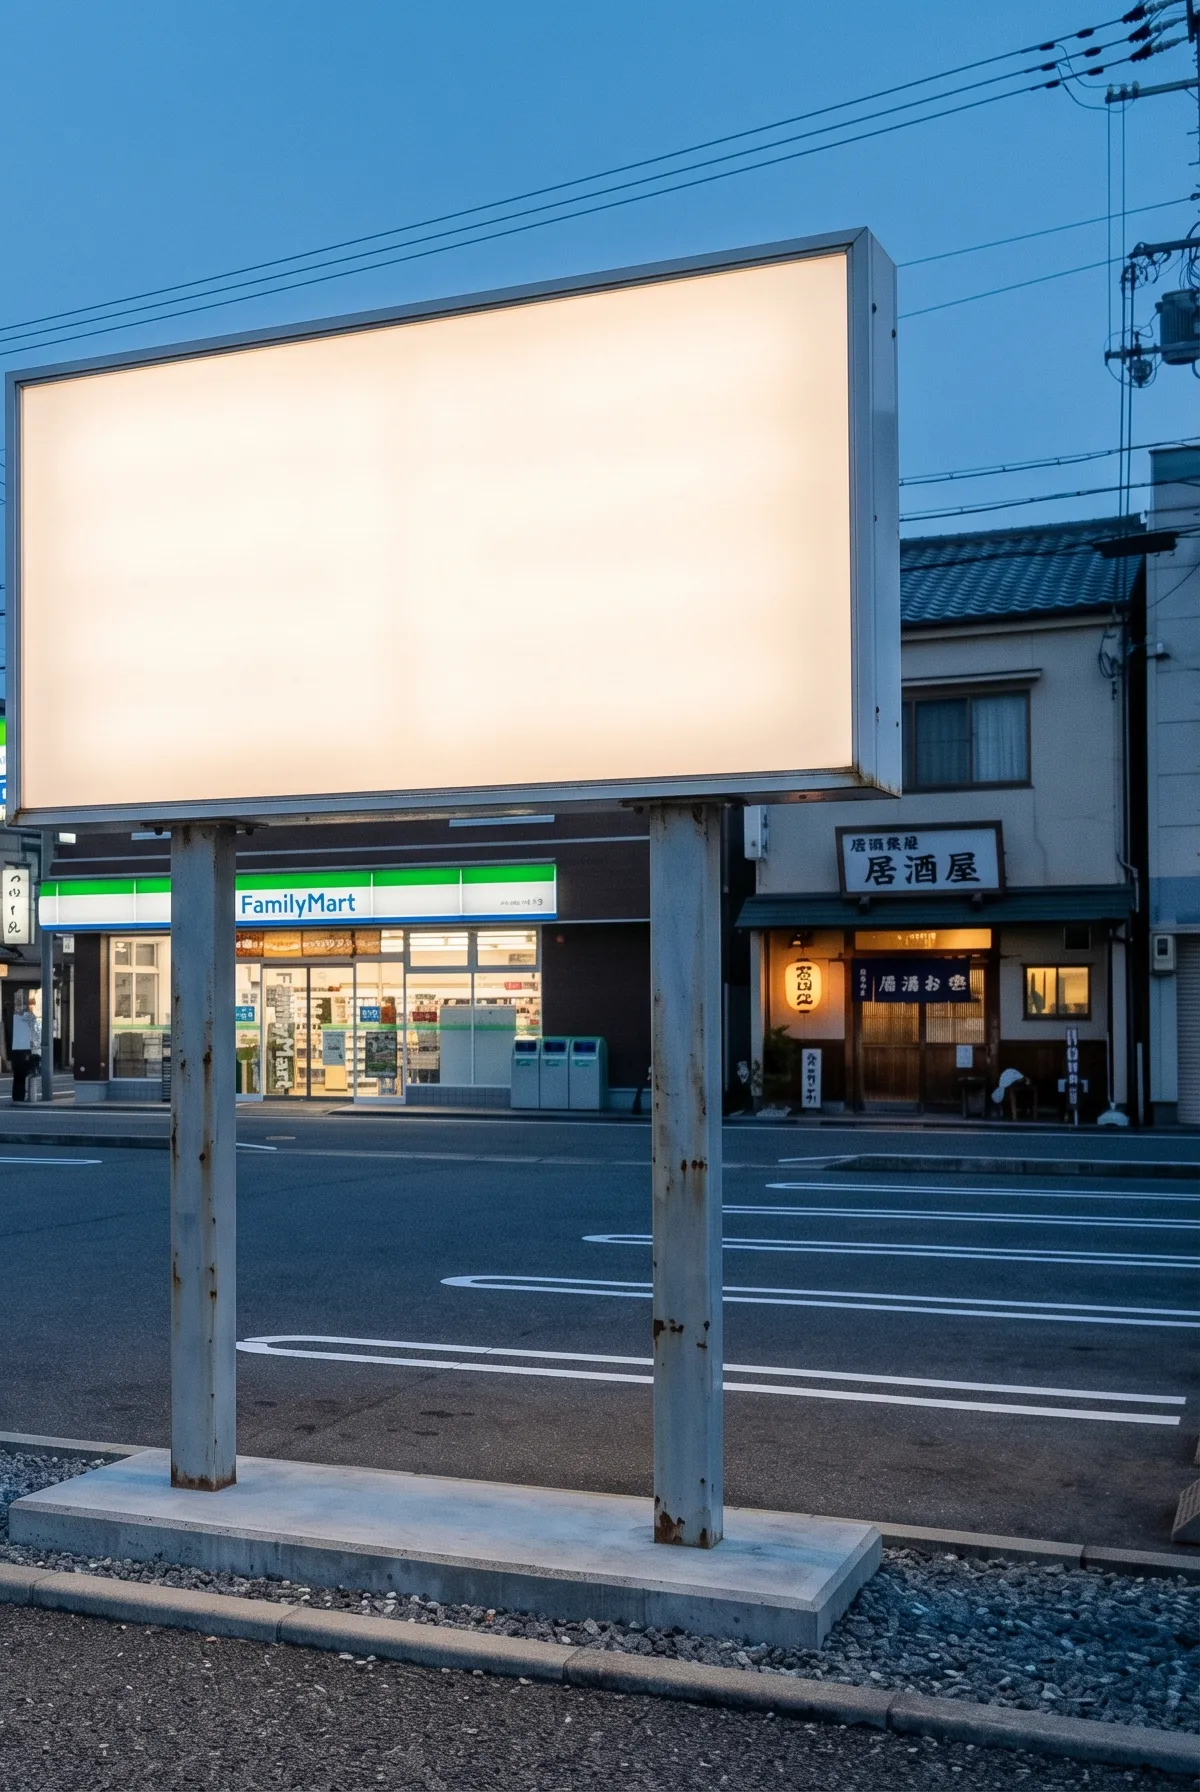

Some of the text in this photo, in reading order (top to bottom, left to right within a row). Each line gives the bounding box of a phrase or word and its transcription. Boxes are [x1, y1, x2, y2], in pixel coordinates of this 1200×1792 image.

[865, 851, 981, 886] 居酒屋
[241, 893, 356, 918] FamilyMart
